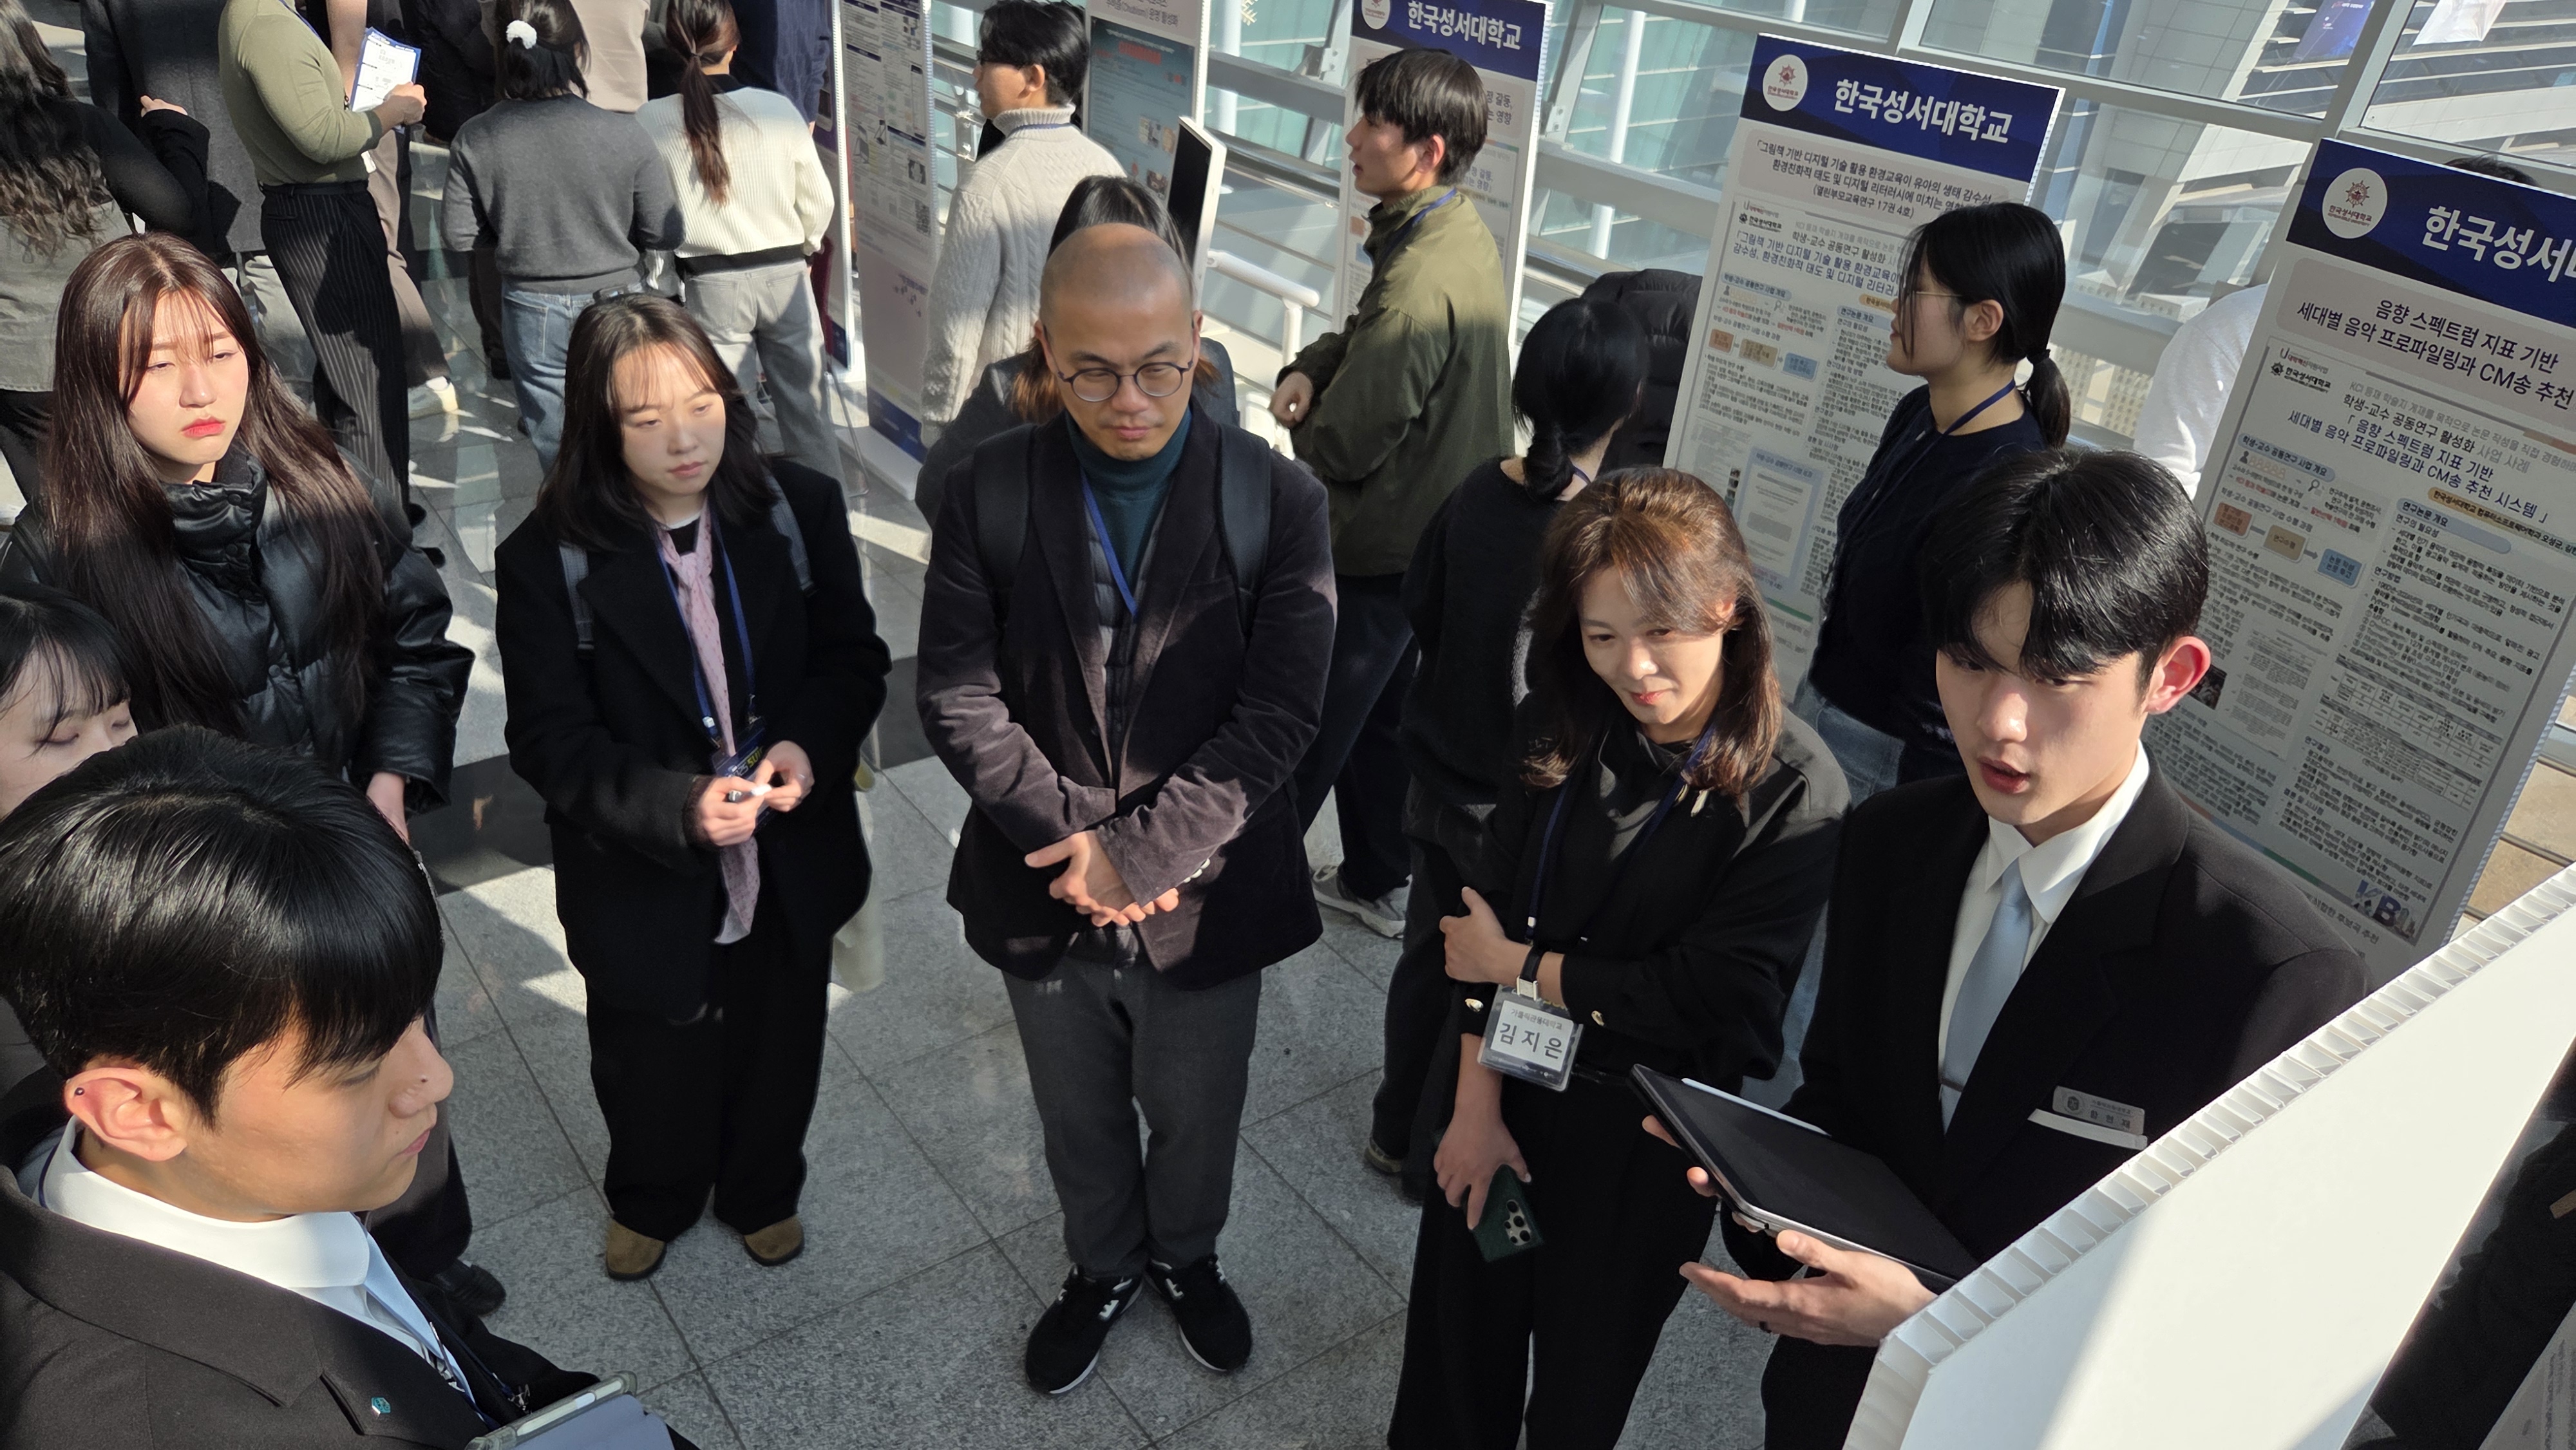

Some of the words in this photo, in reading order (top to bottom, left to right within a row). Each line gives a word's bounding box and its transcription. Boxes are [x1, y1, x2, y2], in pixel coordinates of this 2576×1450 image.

[1408, 1, 1522, 50] 한국성서대학교
[1834, 78, 2013, 144] 한국성서대학교
[1772, 159, 1813, 178] 환경친화적
[1814, 169, 1831, 183] 태도
[1843, 176, 1870, 193] 디지털
[1870, 182, 1915, 203] 리터러시에
[1915, 193, 1943, 211] 미치는
[1785, 147, 1803, 162] 기반
[1804, 152, 1830, 167] 디지털
[1830, 158, 1848, 173] 기술
[1850, 162, 1867, 176] 활용
[1868, 166, 1913, 187] 환경교육이
[1913, 177, 1942, 194] 유아의
[1943, 185, 1962, 199] 생태
[1813, 185, 1875, 208] (열린부모교육연구
[1877, 200, 1896, 214] 17권
[1897, 205, 1915, 219] 4호)
[1762, 250, 1804, 271] 환경친화적
[1805, 263, 1823, 276] 태도
[1837, 271, 1864, 288] 디지털
[1766, 238, 1785, 253] 기반
[1785, 244, 1812, 260] 디지털
[1814, 251, 1832, 265] 기술
[1833, 257, 1852, 271] 활용
[1792, 231, 1826, 248] 학생-교수
[1827, 240, 1860, 256] 공동연구
[1861, 249, 1886, 264] 활성화
[2422, 205, 2576, 282] 한국성서
[2297, 302, 2343, 331] 세대별
[2344, 317, 2377, 343] 음악
[2378, 329, 2476, 376] 프로파일링과
[2479, 363, 2532, 395] CM송
[2535, 382, 2575, 410] 추천
[2376, 299, 2410, 325] 음향
[2410, 312, 2479, 348] 스펙트럼
[2481, 334, 2517, 359] 지표
[2519, 346, 2559, 374] 기반
[2344, 394, 2389, 420] 학생-교수
[2392, 412, 2438, 438] 공동연구
[2439, 430, 2475, 453] 활성화
[2476, 444, 2503, 464] 사업
[2503, 455, 2531, 474] 사례
[2356, 419, 2382, 438] 음향
[2383, 431, 2434, 459] 스펙트럼
[2436, 449, 2463, 471] 지표
[2465, 460, 2494, 483] 기반
[2471, 426, 2490, 440] 논문
[2287, 410, 2323, 434] 세대별
[2324, 424, 2350, 444] 음악
[2351, 435, 2424, 473] 프로파일링과
[2427, 465, 2461, 489] CM송
[2465, 480, 2493, 501] 추천
[2495, 492, 2537, 519] 시스템
[2402, 502, 2432, 520] 연구논문
[2432, 514, 2448, 527] 개요
